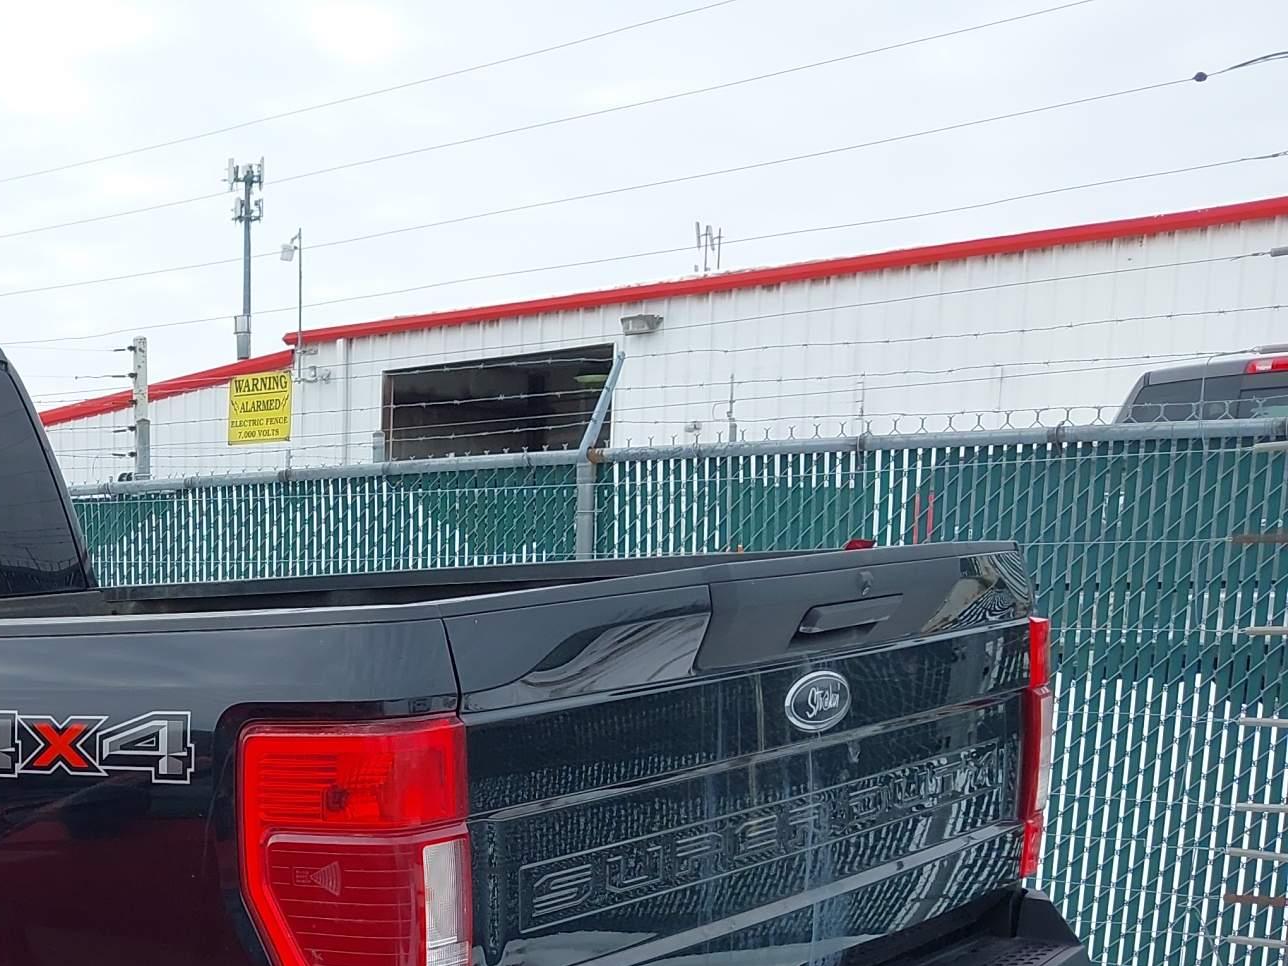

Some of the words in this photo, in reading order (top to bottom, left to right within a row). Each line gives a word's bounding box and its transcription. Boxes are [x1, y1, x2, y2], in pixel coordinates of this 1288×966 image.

[234, 375, 288, 393] WARNING
[239, 398, 281, 413] ALARMED
[231, 419, 264, 428] ELECTRIC
[265, 416, 288, 425] FENCE
[257, 428, 280, 437] VOLTS
[531, 799, 829, 919] SUPER
